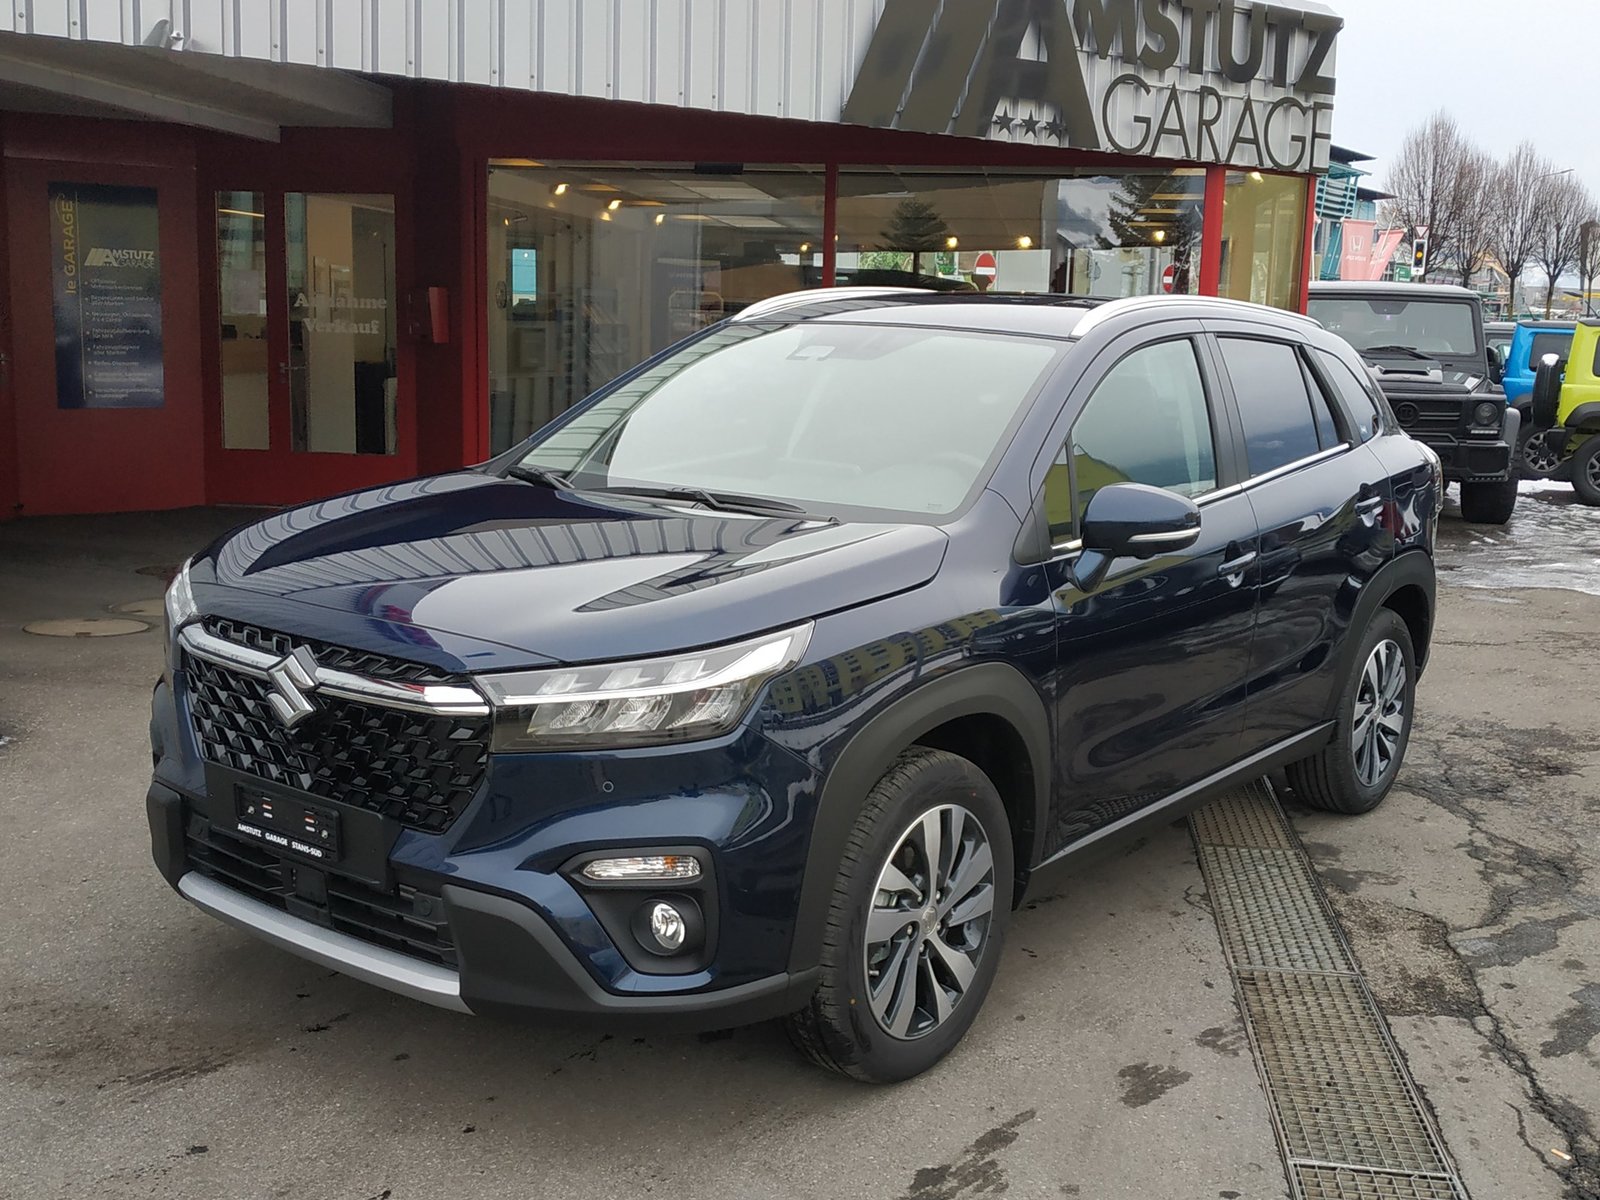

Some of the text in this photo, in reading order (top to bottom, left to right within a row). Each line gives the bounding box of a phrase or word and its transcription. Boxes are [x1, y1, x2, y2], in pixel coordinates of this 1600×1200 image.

[944, 0, 1344, 149] AMSTUTZ
[1102, 73, 1335, 174] GARAGE
[62, 200, 77, 295] le GARAGE
[98, 248, 155, 267] AMSTUTZ
[116, 258, 155, 269] GARAGE
[237, 823, 262, 838] AMSTUTZ
[265, 832, 288, 846] GARAGE
